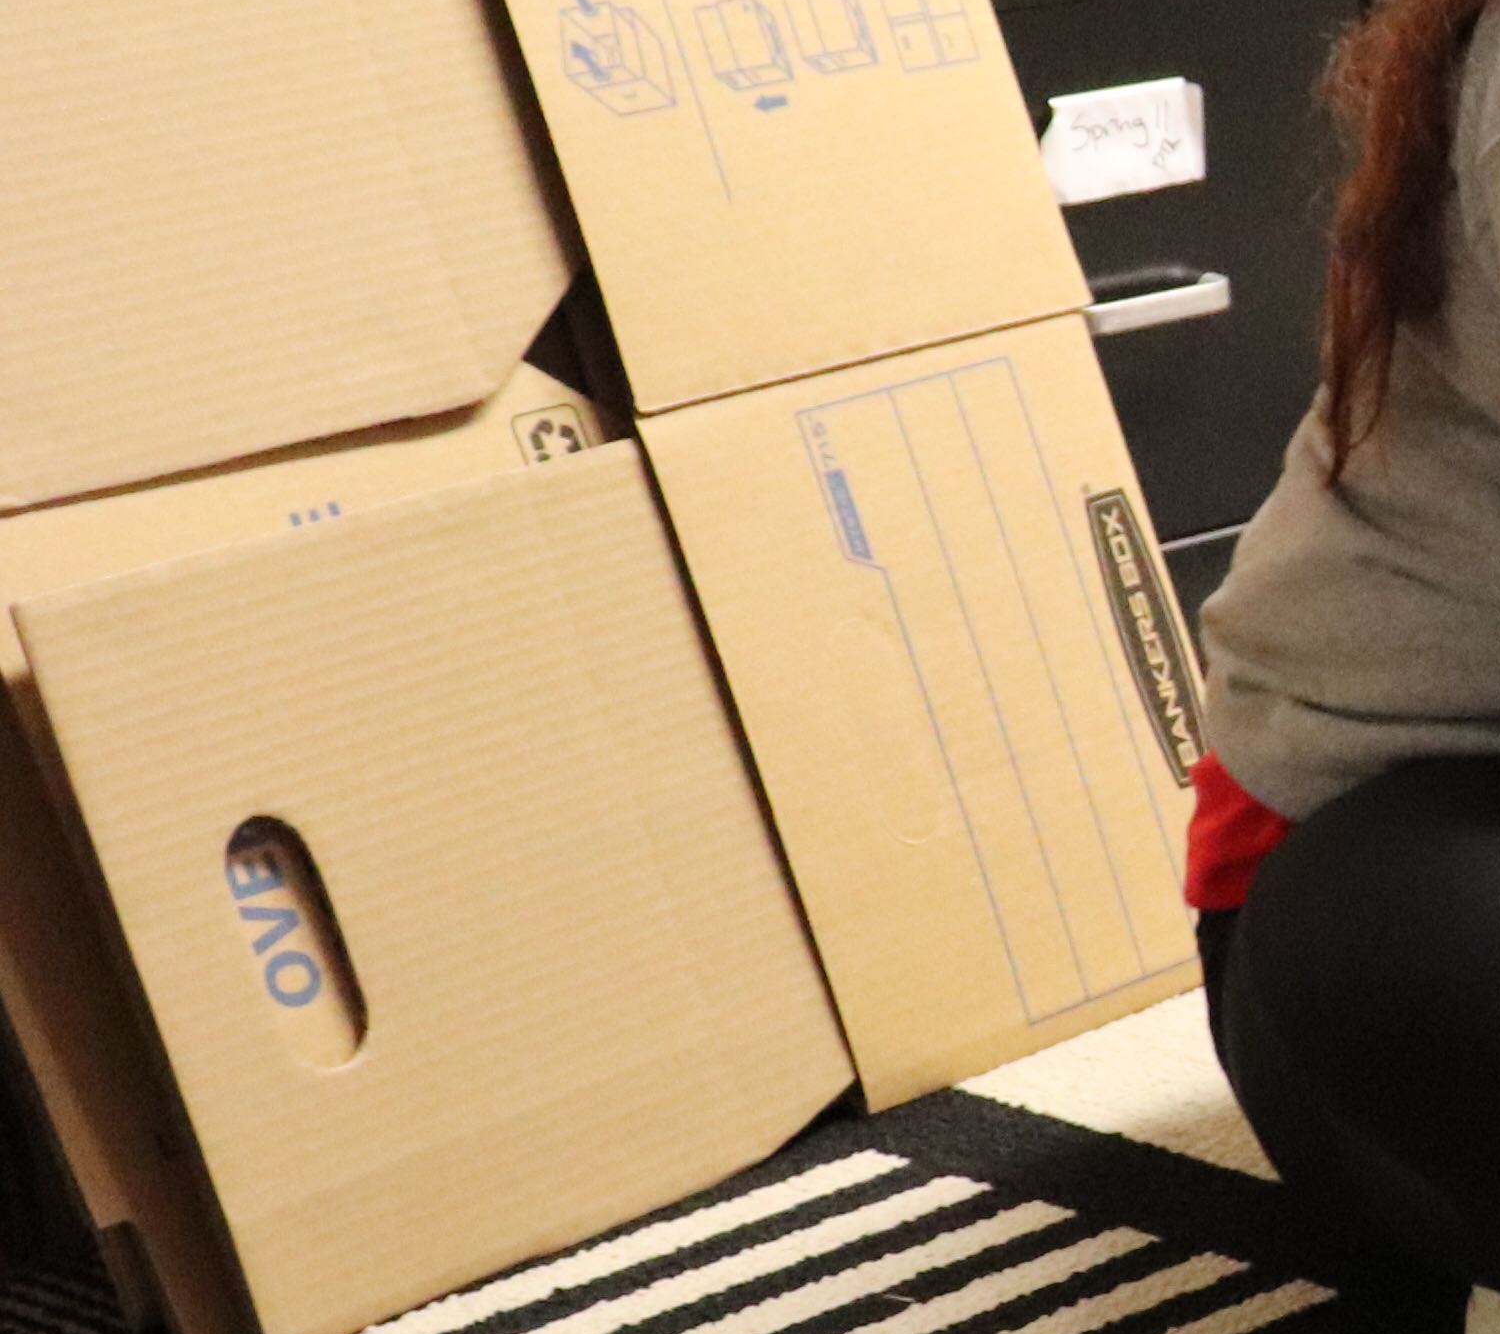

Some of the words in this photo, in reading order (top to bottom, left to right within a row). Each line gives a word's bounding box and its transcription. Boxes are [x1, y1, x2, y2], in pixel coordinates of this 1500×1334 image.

[1070, 108, 1150, 152] Spring
[1101, 505, 1142, 588] BOX
[1127, 591, 1201, 768] BANKERS
